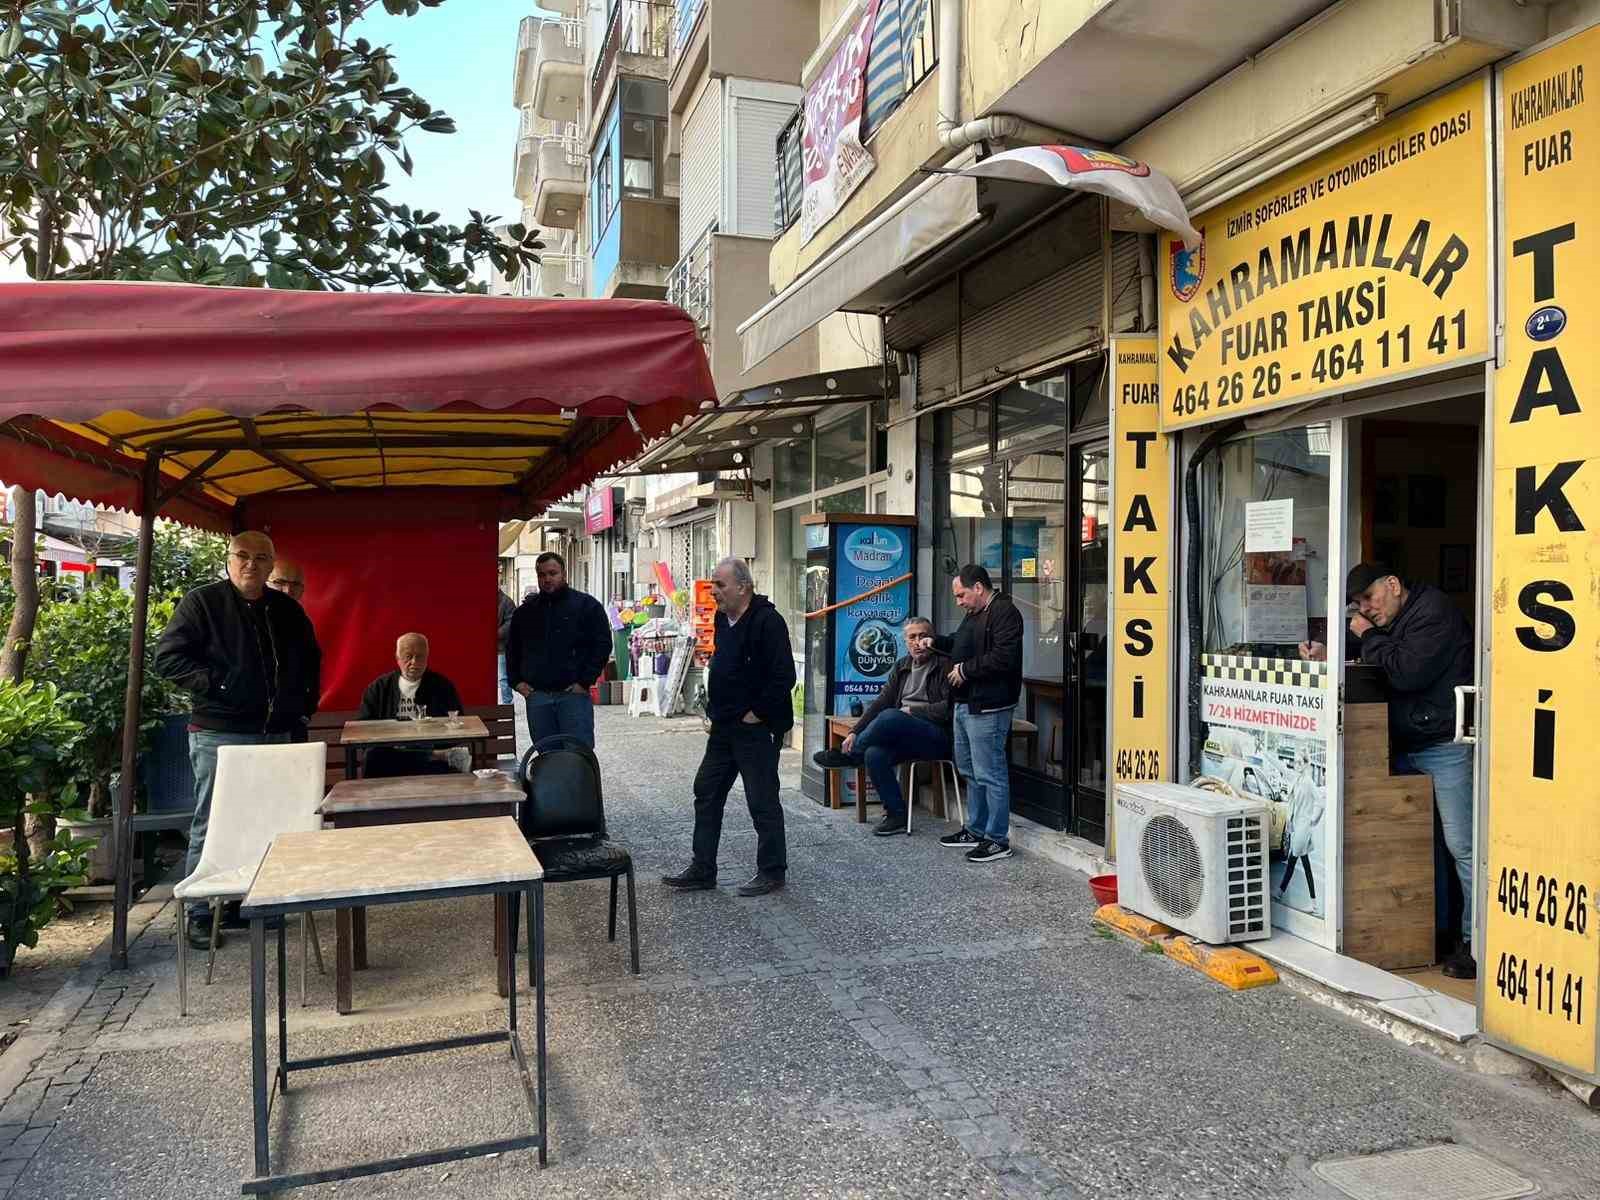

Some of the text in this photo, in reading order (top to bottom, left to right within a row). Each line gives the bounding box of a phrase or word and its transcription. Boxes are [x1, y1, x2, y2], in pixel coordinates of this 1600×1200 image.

[1510, 64, 1585, 130] KAHRAMANLAR
[1226, 110, 1472, 240] İZMİR ŞOFÖRLER VE OTOMOBİLCİLER ODASI
[1523, 129, 1573, 176] FUAR
[1167, 213, 1470, 374] KAHRAMANLAR
[1220, 276, 1386, 366] FUAR TAKSİ
[1118, 352, 1159, 365] KAHRAMANL
[1172, 381, 1209, 417] 464
[1217, 371, 1244, 407] 26
[1252, 361, 1281, 400] 26
[1311, 338, 1364, 384] 464
[1376, 324, 1411, 368] 11
[1427, 309, 1466, 355] 41
[1122, 383, 1160, 405] FUAR
[854, 550, 891, 562] Madran
[1203, 684, 1324, 710] KAHRAMANLAR FUAR TAKSİ
[1208, 703, 1232, 719] 7/24
[1233, 704, 1318, 732] HİZMETİNİZDE
[1115, 749, 1160, 780] 464 26 26
[1498, 866, 1588, 935] 464 26 26
[1496, 952, 1584, 1026] 464 11 41
